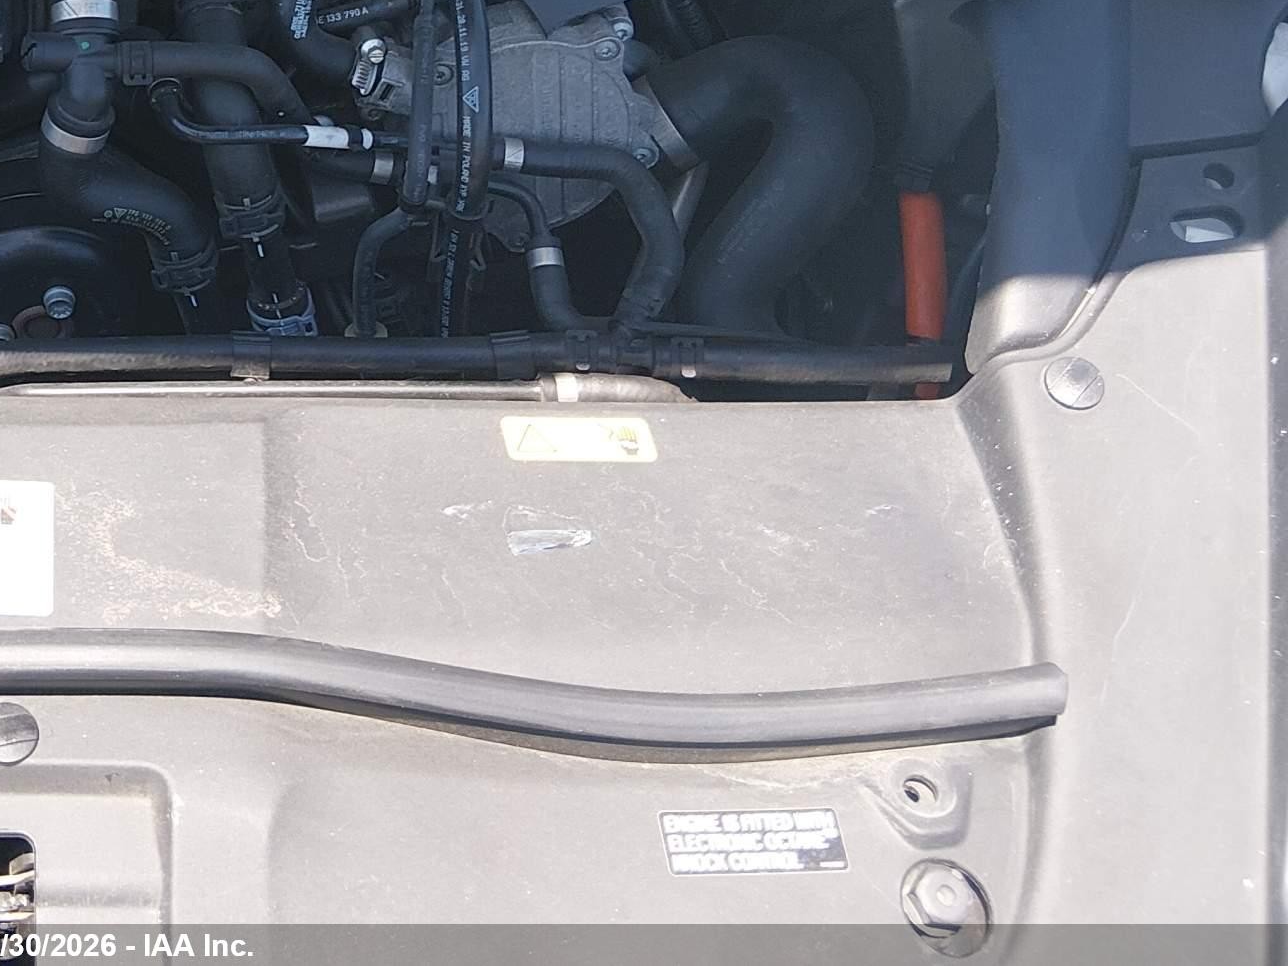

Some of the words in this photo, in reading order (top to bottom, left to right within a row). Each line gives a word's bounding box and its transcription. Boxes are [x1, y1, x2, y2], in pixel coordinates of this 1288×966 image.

[326, 12, 341, 22] 133
[343, 8, 360, 19] 790
[462, 115, 471, 138] MADE
[460, 155, 470, 183] POLAND
